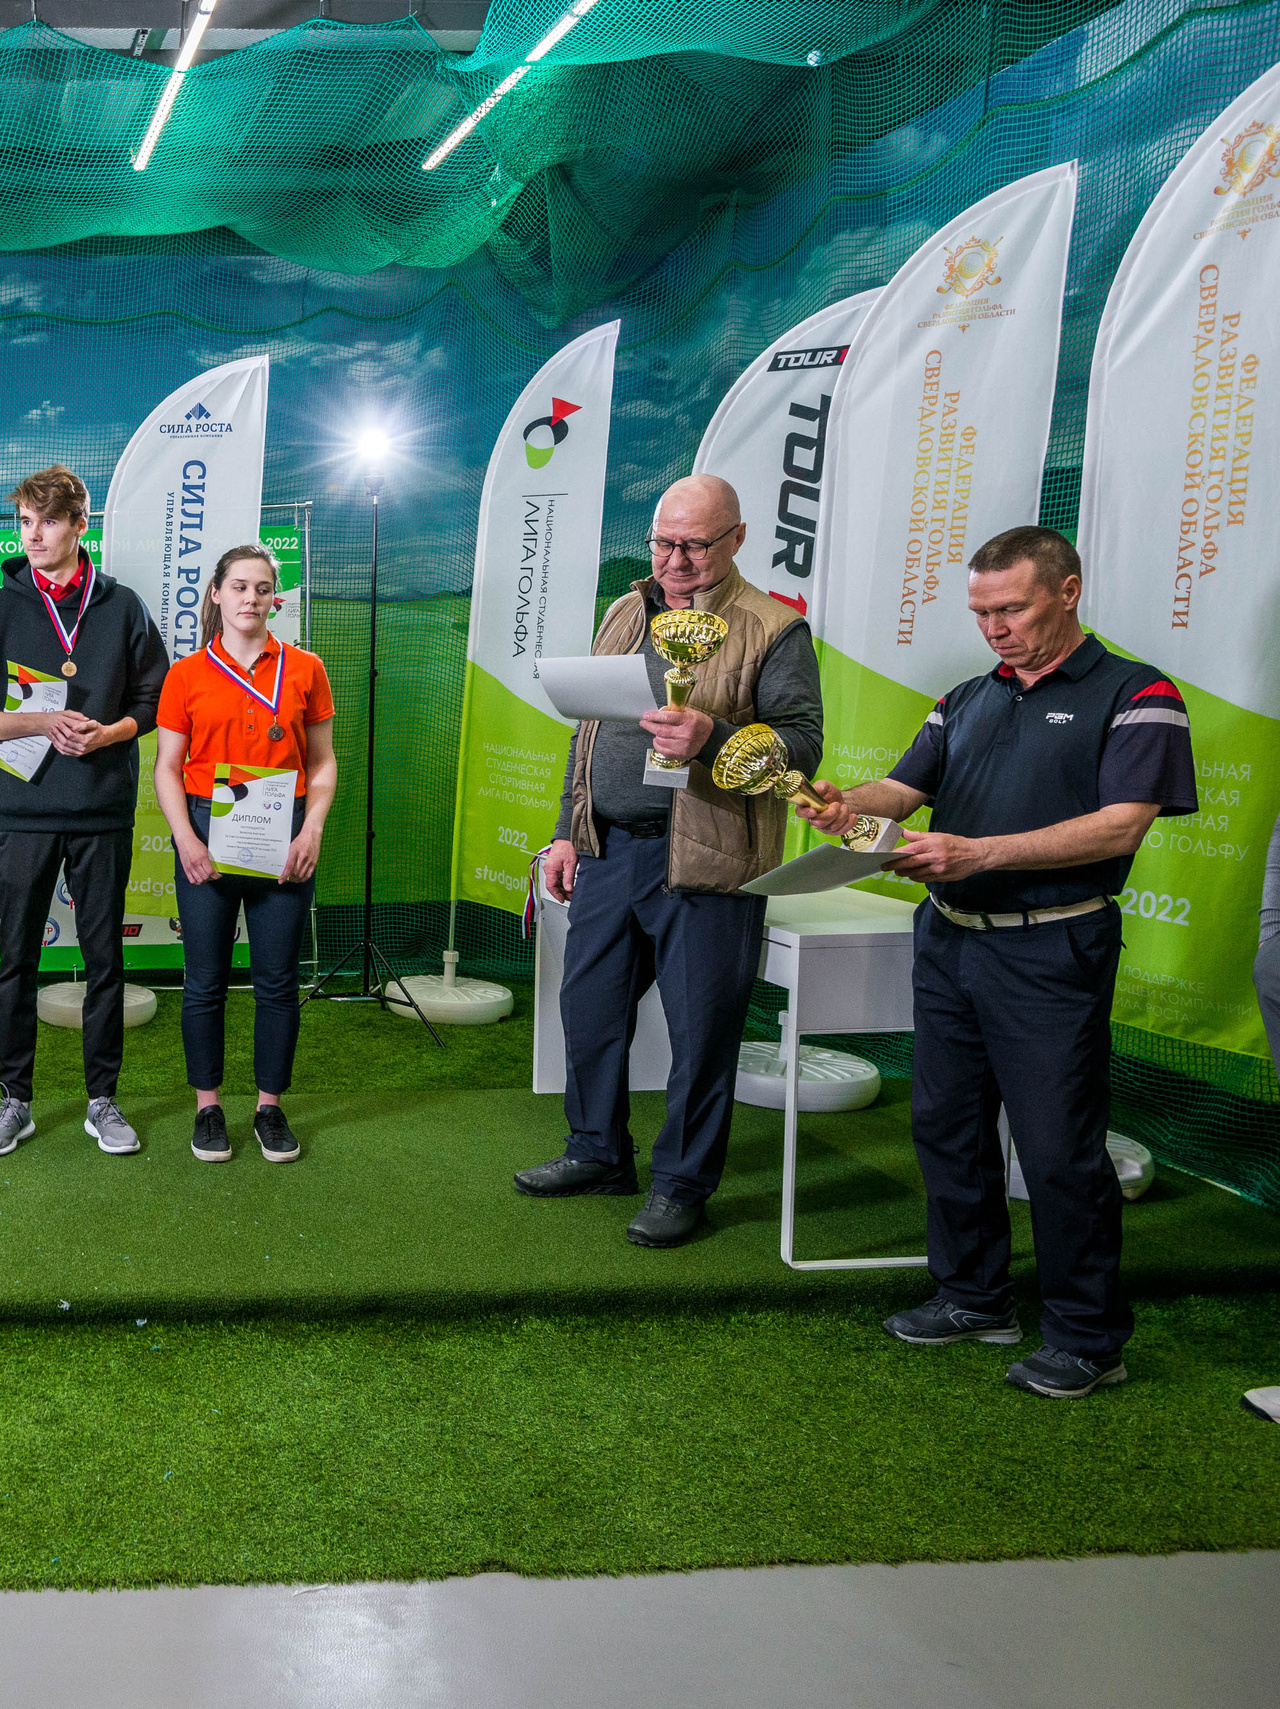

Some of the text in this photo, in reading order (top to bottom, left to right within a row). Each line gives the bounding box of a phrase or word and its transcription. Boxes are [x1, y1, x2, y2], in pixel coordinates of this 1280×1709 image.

[970, 303, 1003, 313] ГОЛЬФА
[977, 308, 1016, 320] ОБЛАСТИ
[777, 349, 835, 367] TOUR
[159, 423, 233, 434] СИЛА РОСТА
[1226, 353, 1259, 527] ФЕДЕРАЦИЯ
[1171, 264, 1220, 630] СВЕРДЛОВСКОЙ ОБЛАСТИ
[1199, 311, 1241, 579] РАЗВИТИЯ ГОЛЬФА
[771, 394, 832, 579] TOUR
[897, 349, 942, 646] СВЕРДЛОВСКОЙ ОБЛАСТИ
[921, 390, 960, 605] РАЗВИТИЯ ГОЛЬФА
[947, 425, 978, 564] ФЕДЕРАЦИЯ
[179, 460, 207, 558] СИЛА
[163, 492, 174, 578] УПРАВЛЯЮЩАЯ
[265, 537, 298, 550] 2022
[539, 499, 555, 593] НАЦИОНАЛЬНАЯ
[512, 501, 540, 658] ЛИГА ГОЛЬФА
[1045, 712, 1074, 721] PGM
[482, 741, 557, 764] НАЦИОНАЛЬНАЯ
[832, 744, 899, 762] НАЦИОН
[486, 757, 551, 779] СТУДЕНЧЕСКАЯ
[489, 772, 545, 794] СПОРТИВНАЯ
[478, 786, 554, 811] ЛИГА ПО ГОЛЬФУ
[232, 813, 272, 824] ДИПЛОМ
[498, 826, 528, 850] 2022
[1169, 834, 1250, 862] ГОЛЬФУ
[475, 864, 528, 892] studgolf
[1120, 887, 1191, 926] 2022
[1123, 965, 1206, 994] ПОДДЕРЖКЕ
[1159, 991, 1253, 1018] КОМПАНИИ
